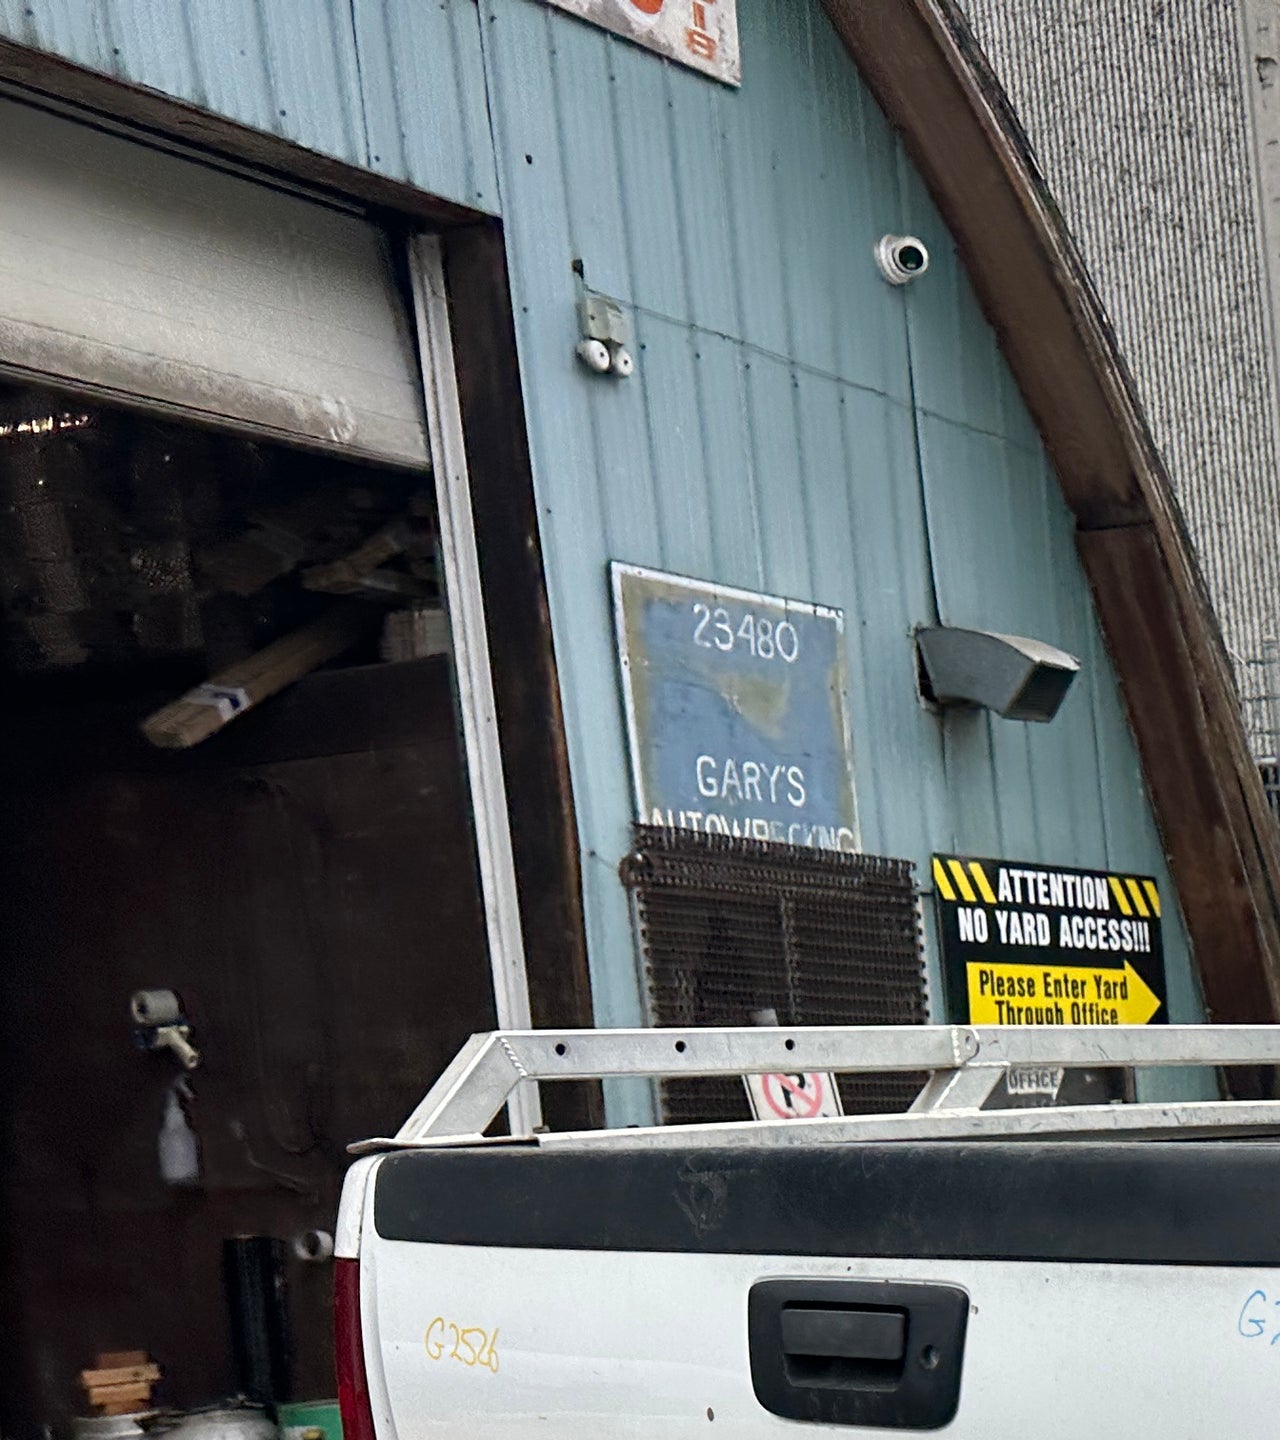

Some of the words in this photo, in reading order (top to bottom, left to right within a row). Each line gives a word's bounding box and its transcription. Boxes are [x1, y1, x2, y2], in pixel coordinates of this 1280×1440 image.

[692, 602, 799, 664] 23480
[695, 754, 807, 808] GARY'S
[997, 867, 1111, 911] ATTENTION
[956, 906, 990, 944] NO
[994, 910, 1051, 947] YARD
[1059, 914, 1151, 953] ACCESS!!!
[978, 969, 1036, 998] Please
[1042, 971, 1088, 1000] Enter
[1092, 974, 1129, 1001] Yard
[994, 1000, 1065, 1025] Through
[1070, 1003, 1119, 1025] Office
[1008, 1069, 1061, 1091] OFFICE
[424, 1316, 500, 1373] G2526
